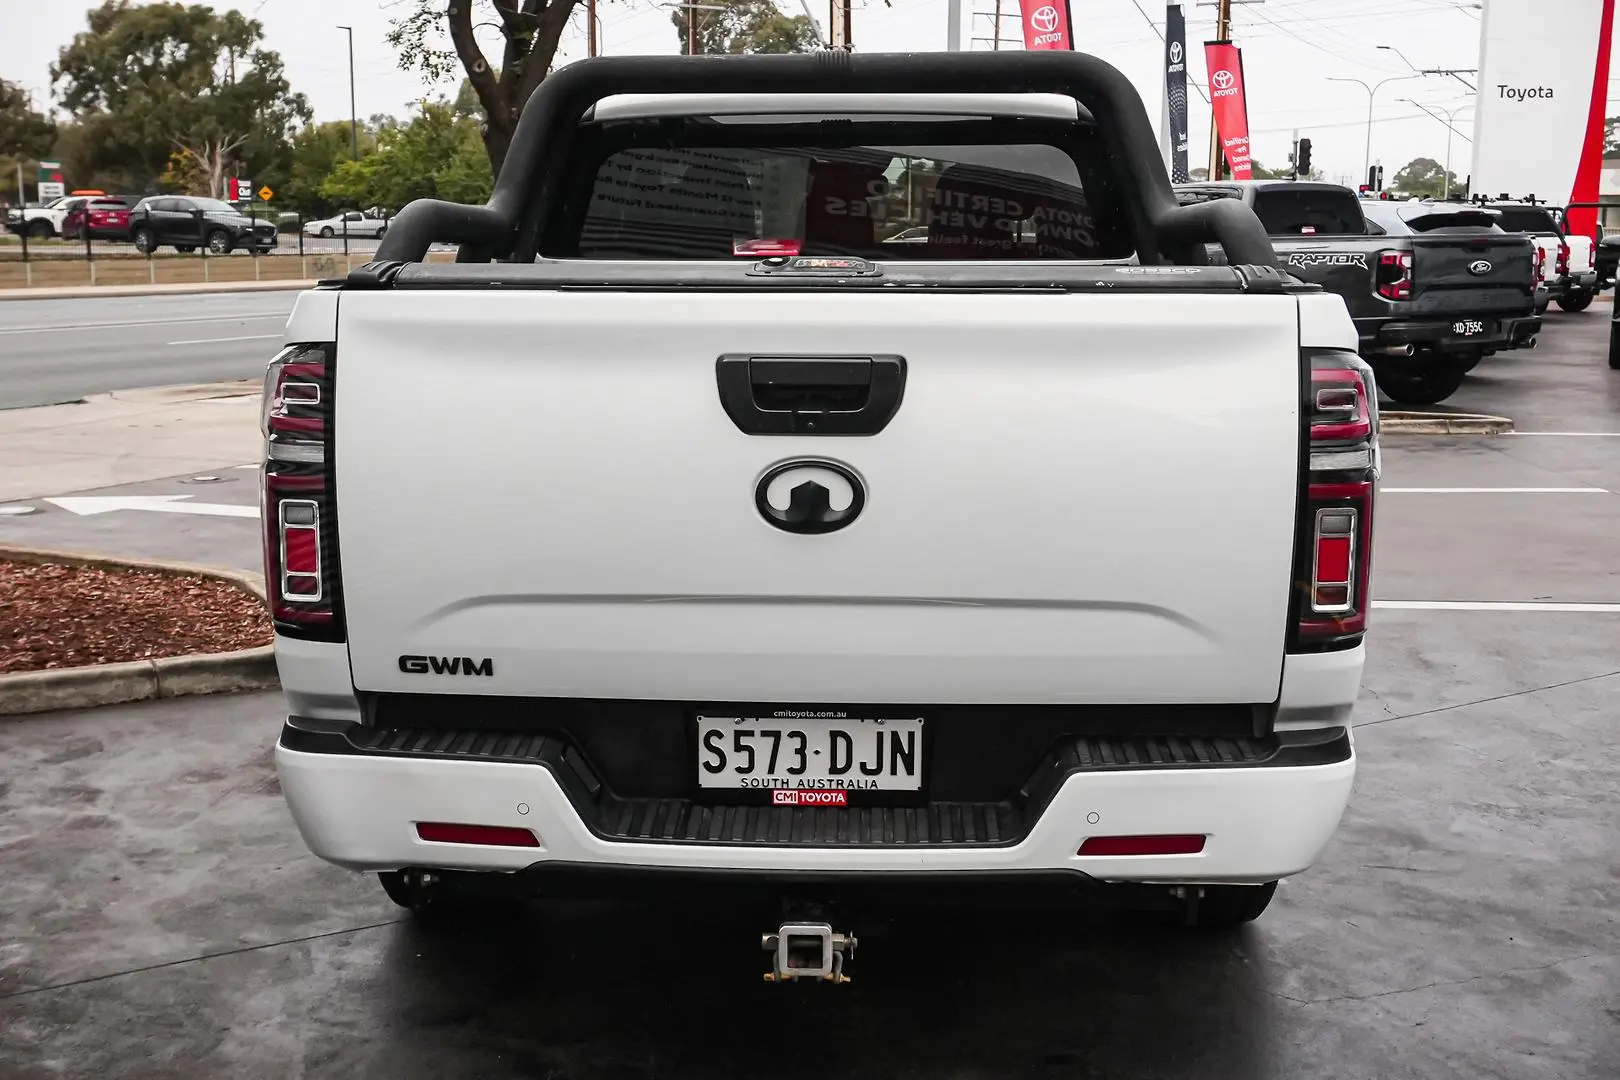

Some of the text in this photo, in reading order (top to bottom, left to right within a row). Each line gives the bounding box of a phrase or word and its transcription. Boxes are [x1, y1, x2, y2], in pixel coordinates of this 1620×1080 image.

[1497, 85, 1554, 102] Toyota
[1288, 253, 1369, 271] RAPTOR
[398, 655, 494, 677] GWM
[773, 709, 847, 719] cmitoyota.com.au
[740, 777, 879, 789] SOUTH AUSTRALIA
[774, 791, 845, 803] CMI TOYOTA
